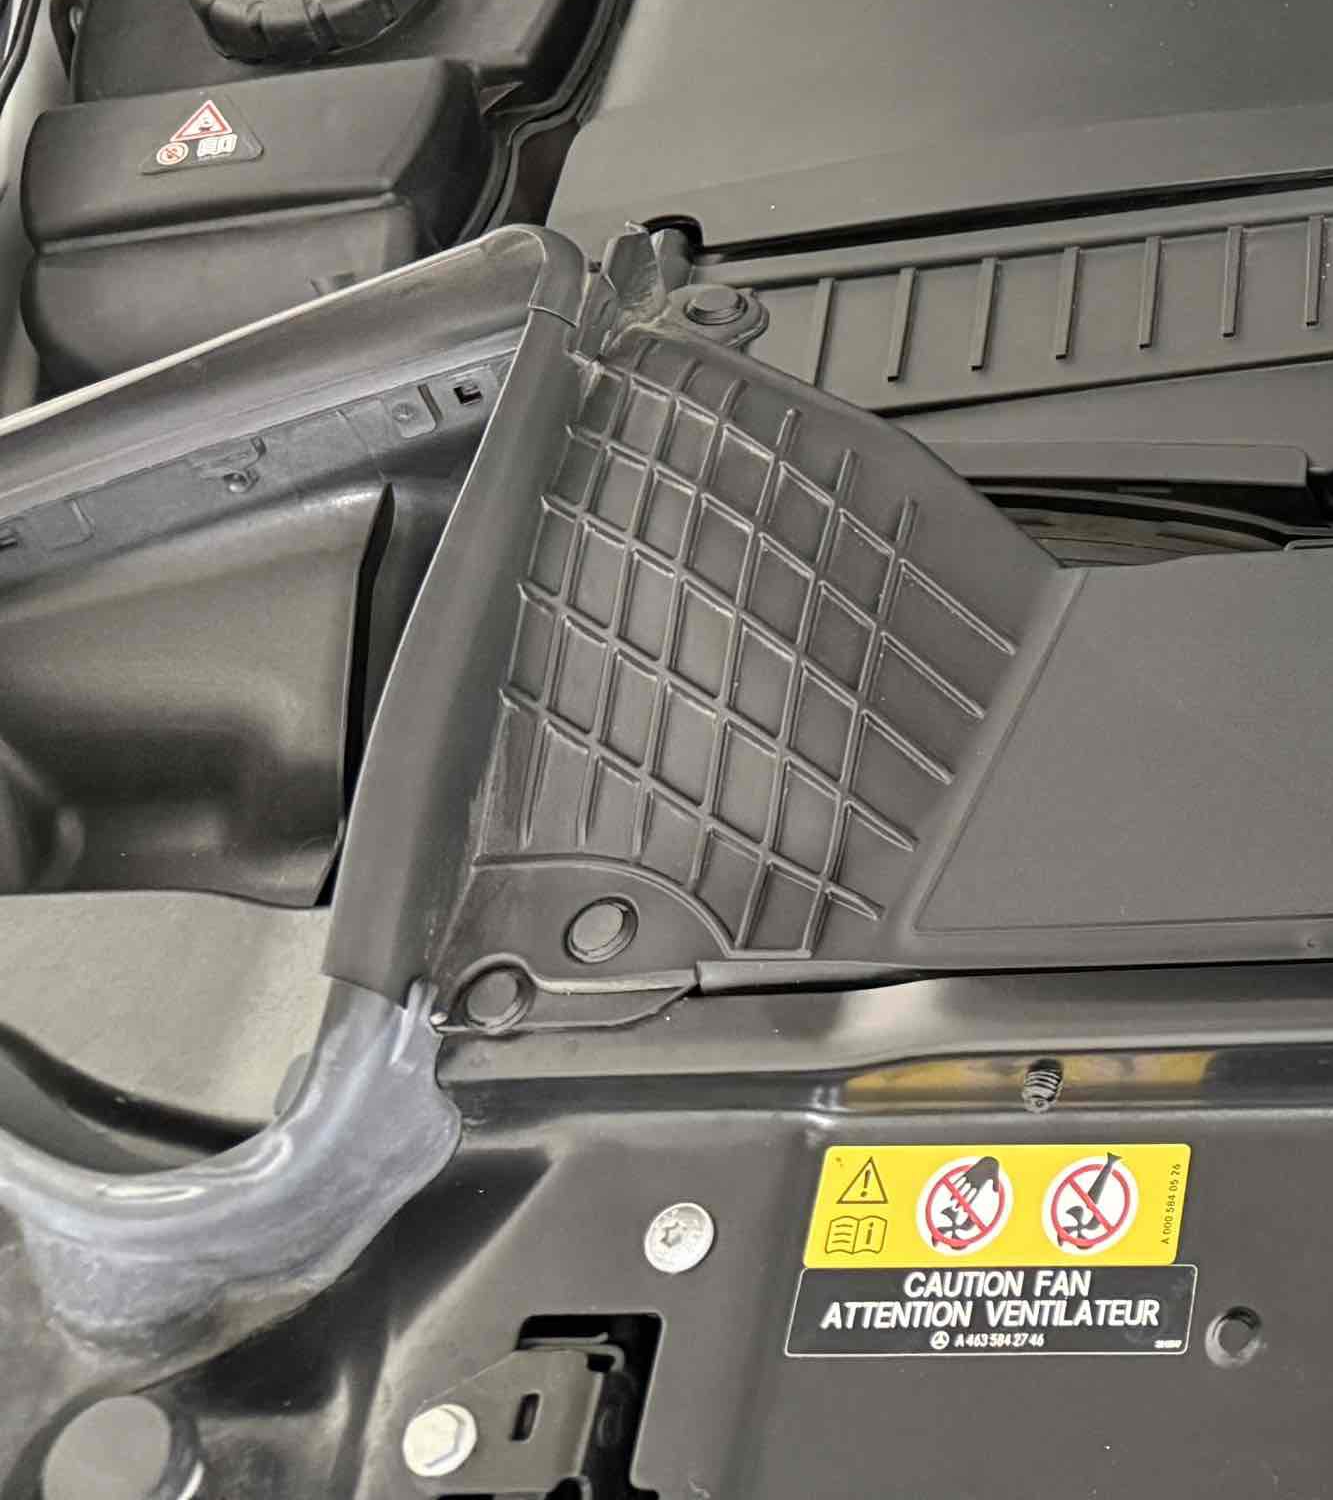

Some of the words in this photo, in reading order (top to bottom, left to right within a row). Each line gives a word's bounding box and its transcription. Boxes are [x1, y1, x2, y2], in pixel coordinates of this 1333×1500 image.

[1168, 1179, 1179, 1192] 05
[1165, 1194, 1176, 1213] 584
[1162, 1216, 1173, 1235] 000
[904, 1271, 1024, 1298] CAUTION
[1034, 1270, 1092, 1297] FAN
[820, 1301, 972, 1329] ATTENTION
[987, 1299, 1160, 1328] VENTILATEUR
[954, 1333, 964, 1348] A
[966, 1332, 988, 1348] 463
[990, 1332, 1012, 1348] 584
[1012, 1332, 1029, 1347] 27
[1028, 1332, 1044, 1347] 46
